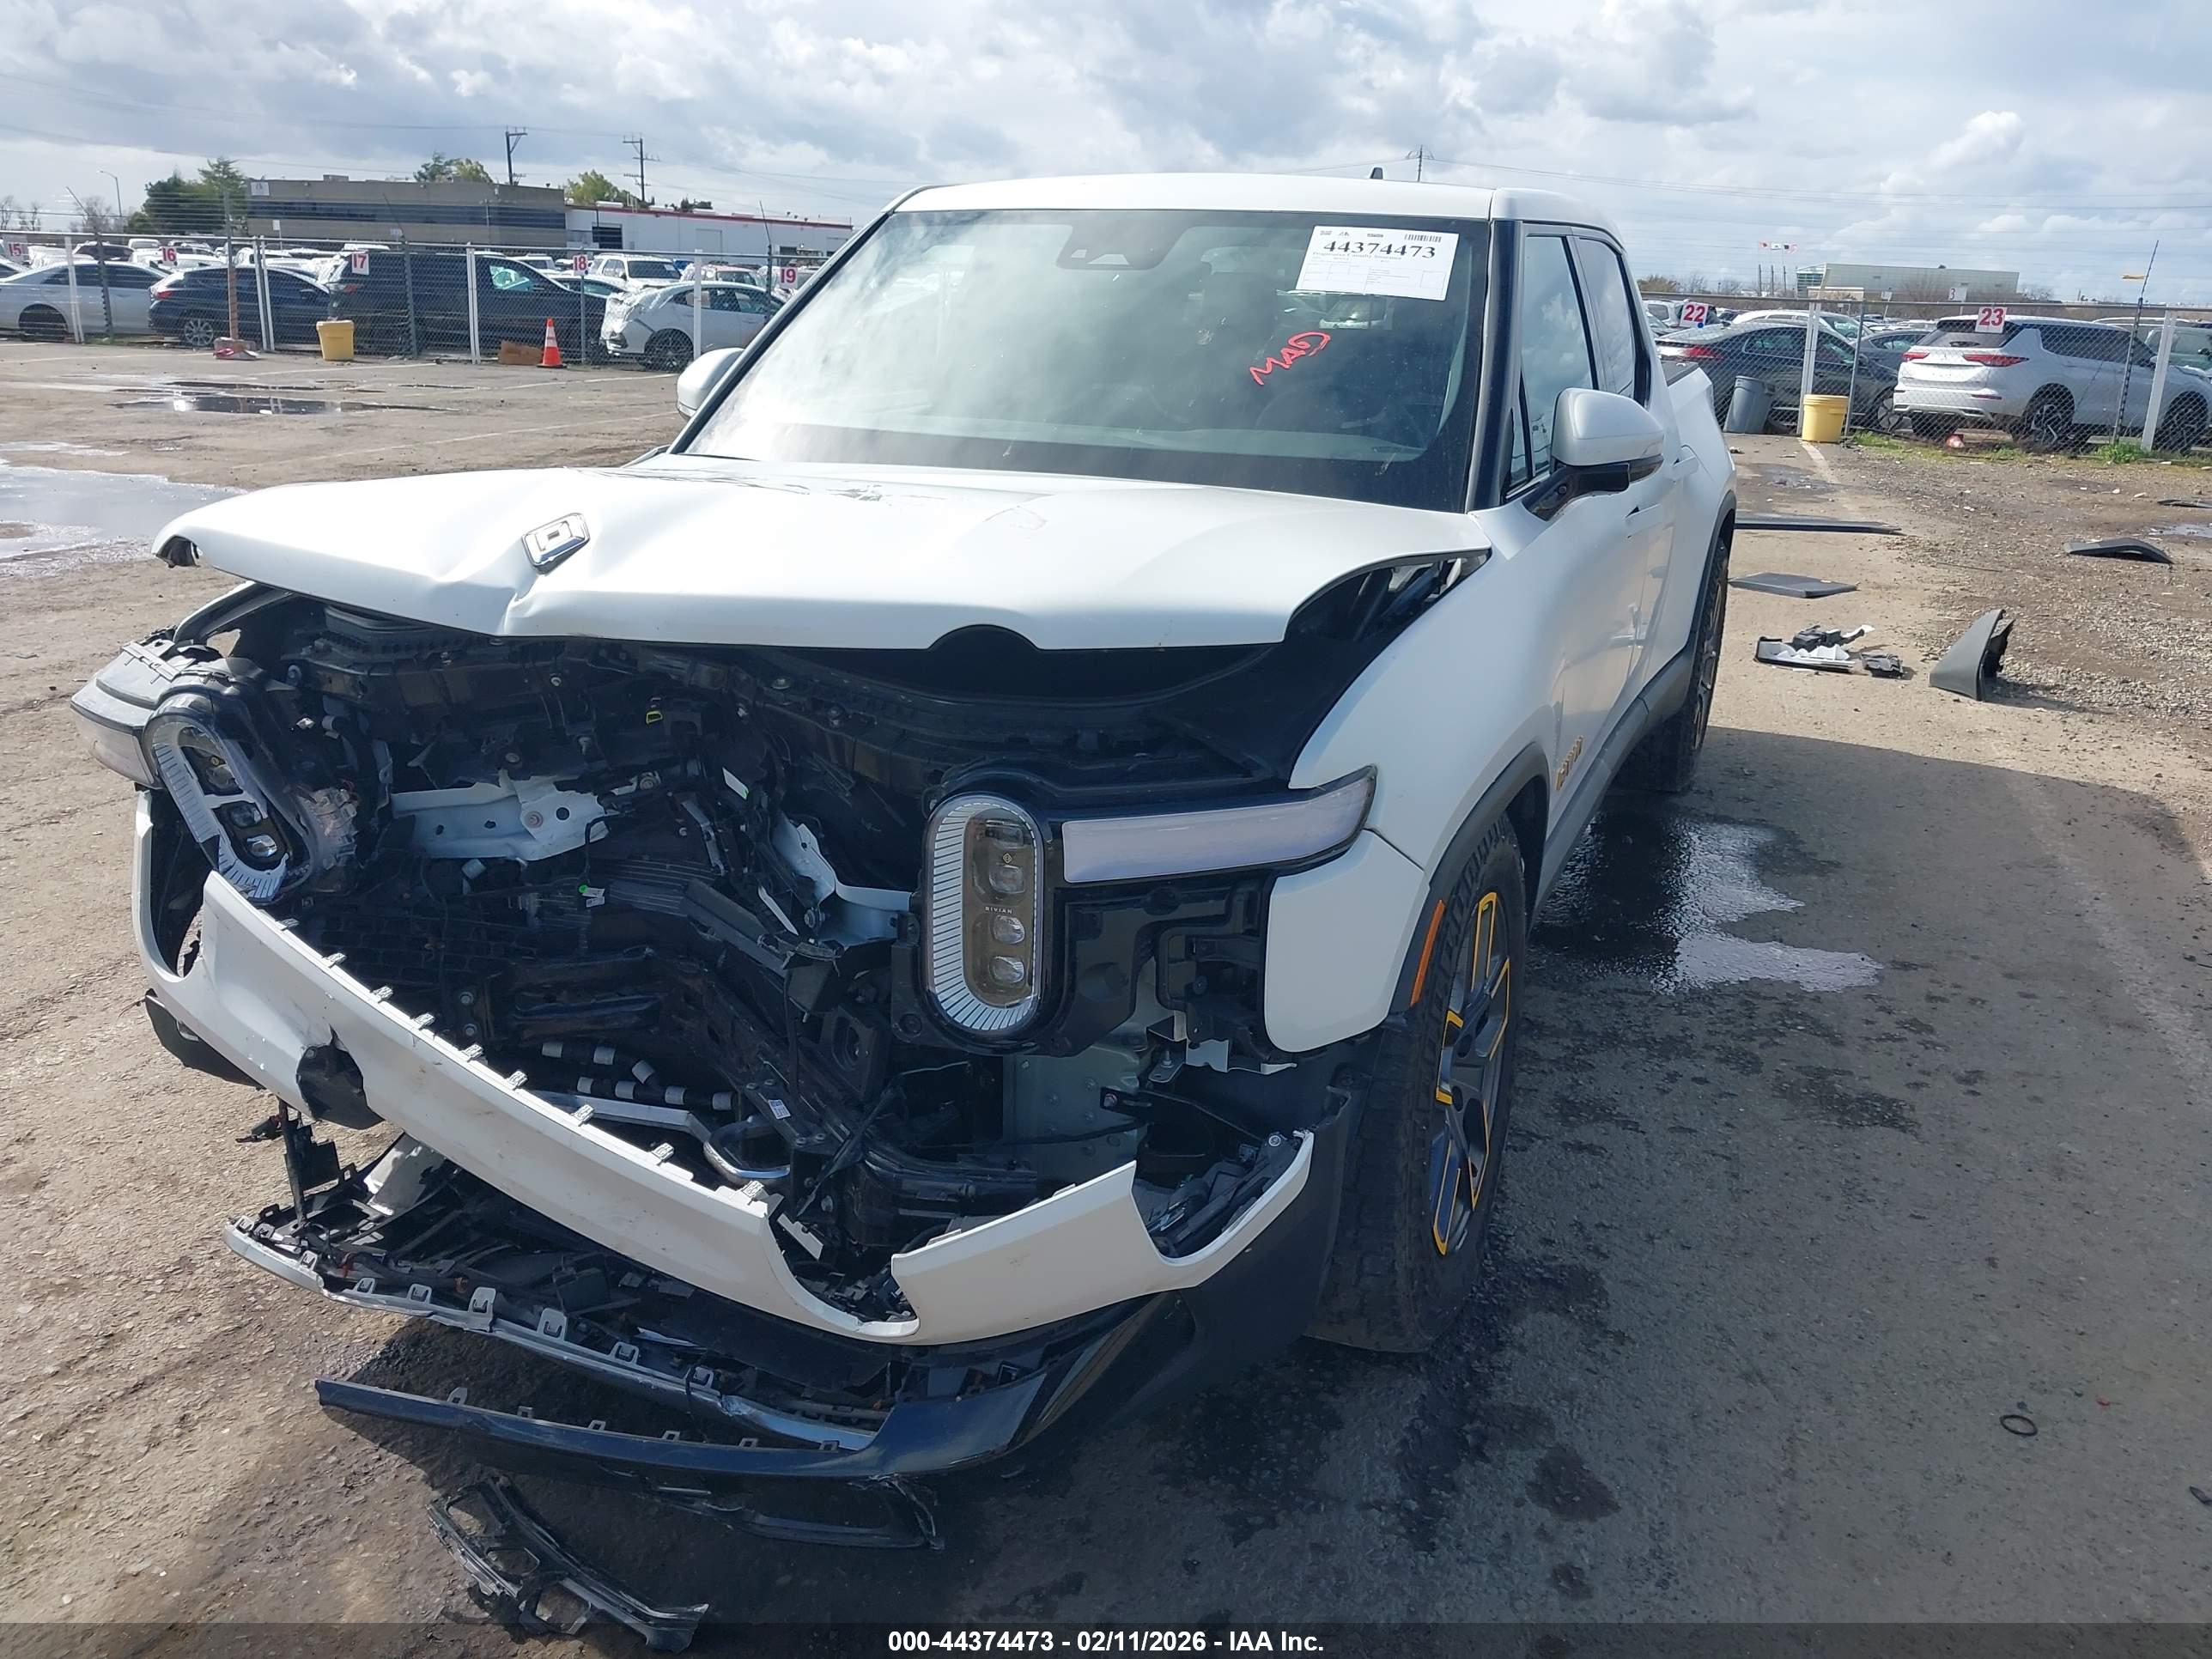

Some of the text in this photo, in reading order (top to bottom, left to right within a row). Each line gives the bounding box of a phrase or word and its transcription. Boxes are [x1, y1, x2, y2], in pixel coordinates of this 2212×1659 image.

[9, 243, 21, 256] 15
[162, 247, 176, 262] 16
[1323, 240, 1436, 259] 44374473
[353, 253, 367, 268] 17
[574, 256, 587, 270] 18
[781, 268, 796, 283] 19
[1683, 304, 1705, 322] 22
[1978, 307, 2004, 326] 23
